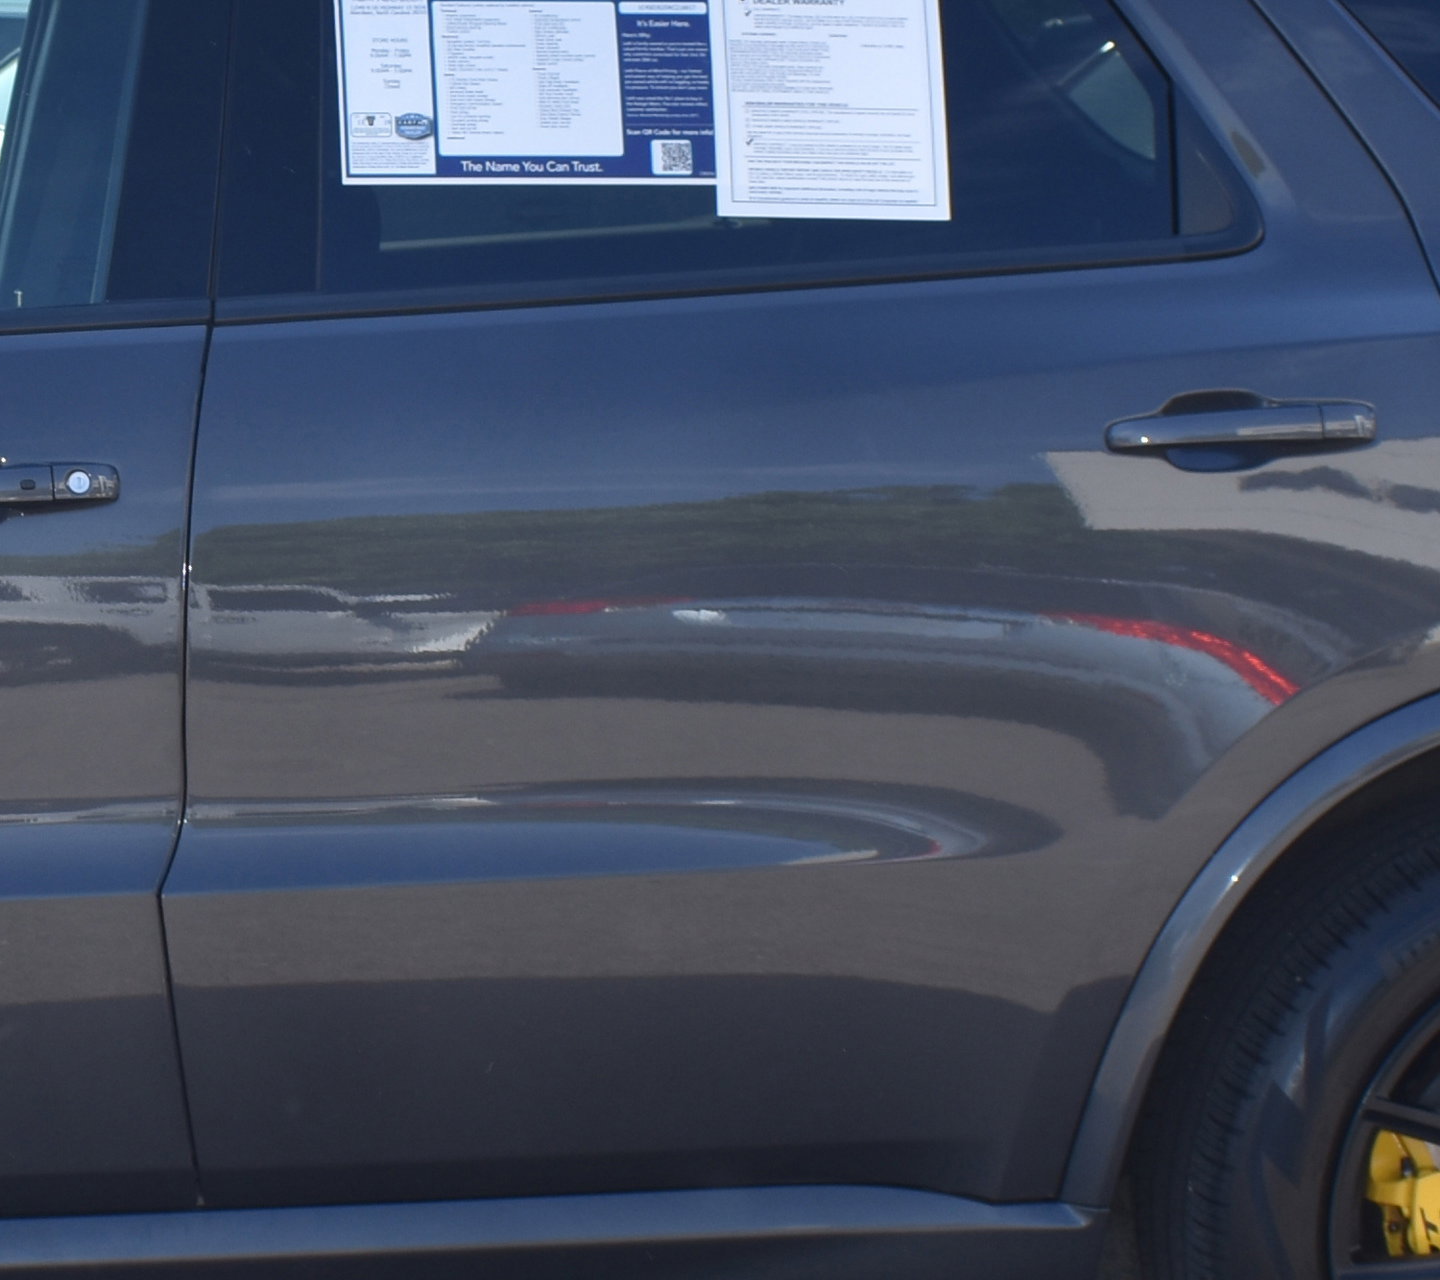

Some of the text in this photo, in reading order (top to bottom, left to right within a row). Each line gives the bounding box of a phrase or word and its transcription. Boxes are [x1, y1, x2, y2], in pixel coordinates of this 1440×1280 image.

[460, 160, 604, 173] The Name You Can Trust.
